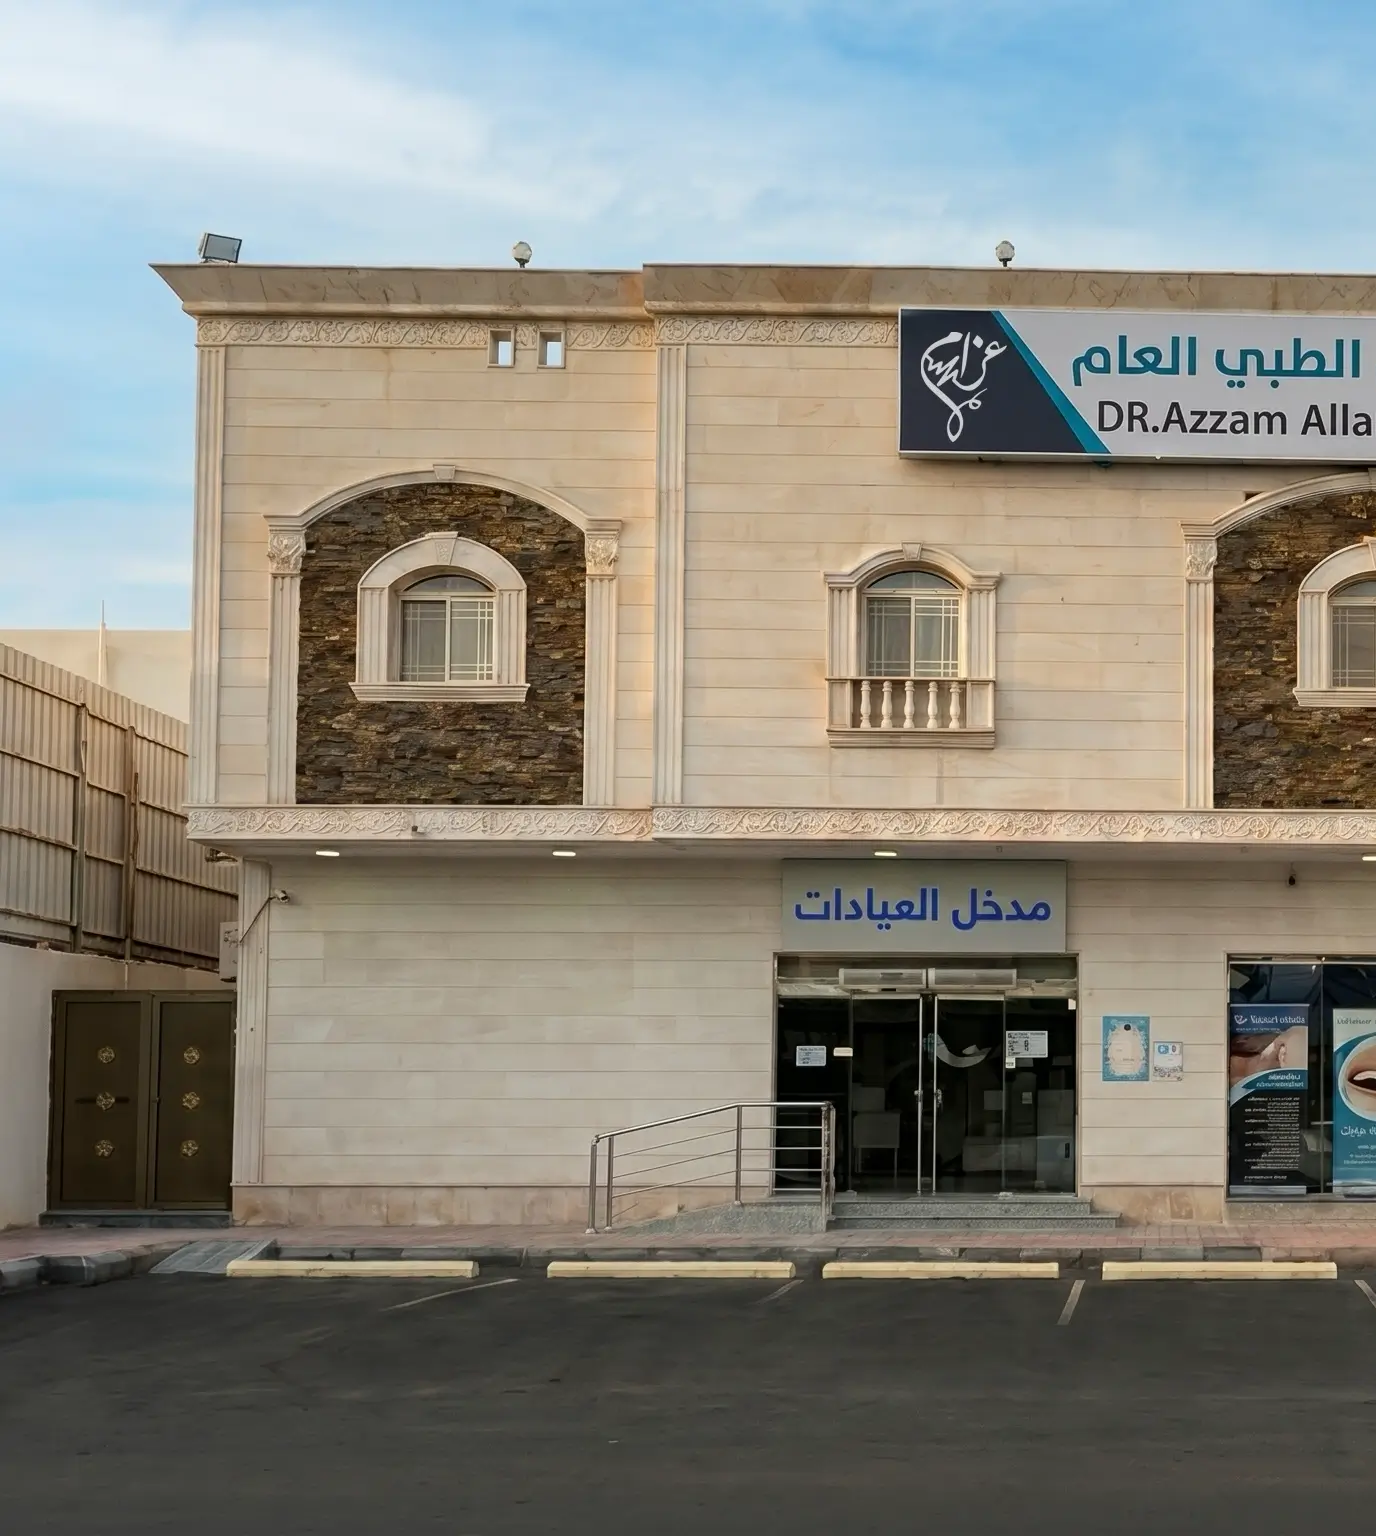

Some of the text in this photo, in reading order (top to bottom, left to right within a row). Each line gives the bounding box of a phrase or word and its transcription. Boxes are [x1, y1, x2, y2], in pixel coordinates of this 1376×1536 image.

[1071, 334, 1198, 387] العام
[1214, 337, 1361, 389] الطبي
[1097, 400, 1288, 435] DR.Azzam
[794, 886, 1053, 931] مدخل العيادات
